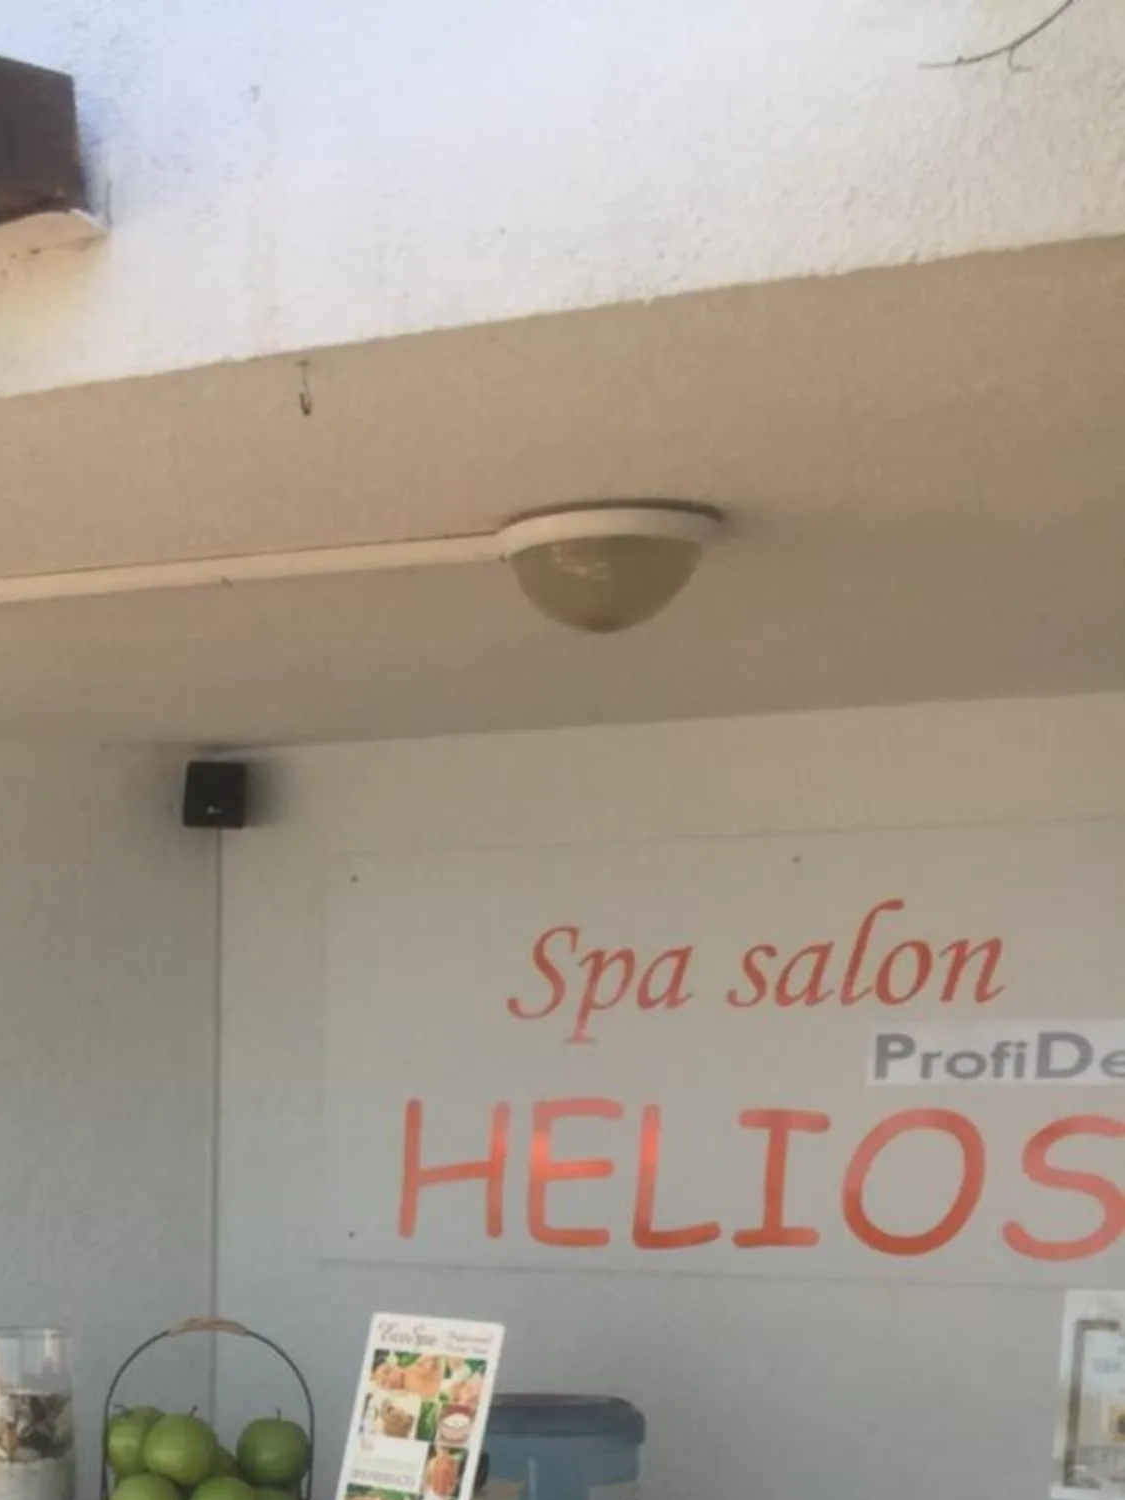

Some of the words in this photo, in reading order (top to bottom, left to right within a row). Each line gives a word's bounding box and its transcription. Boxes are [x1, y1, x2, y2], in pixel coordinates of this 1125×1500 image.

[506, 925, 693, 1045] Spa
[726, 898, 1005, 1007] salon
[398, 1098, 1125, 1261] HELIOS
